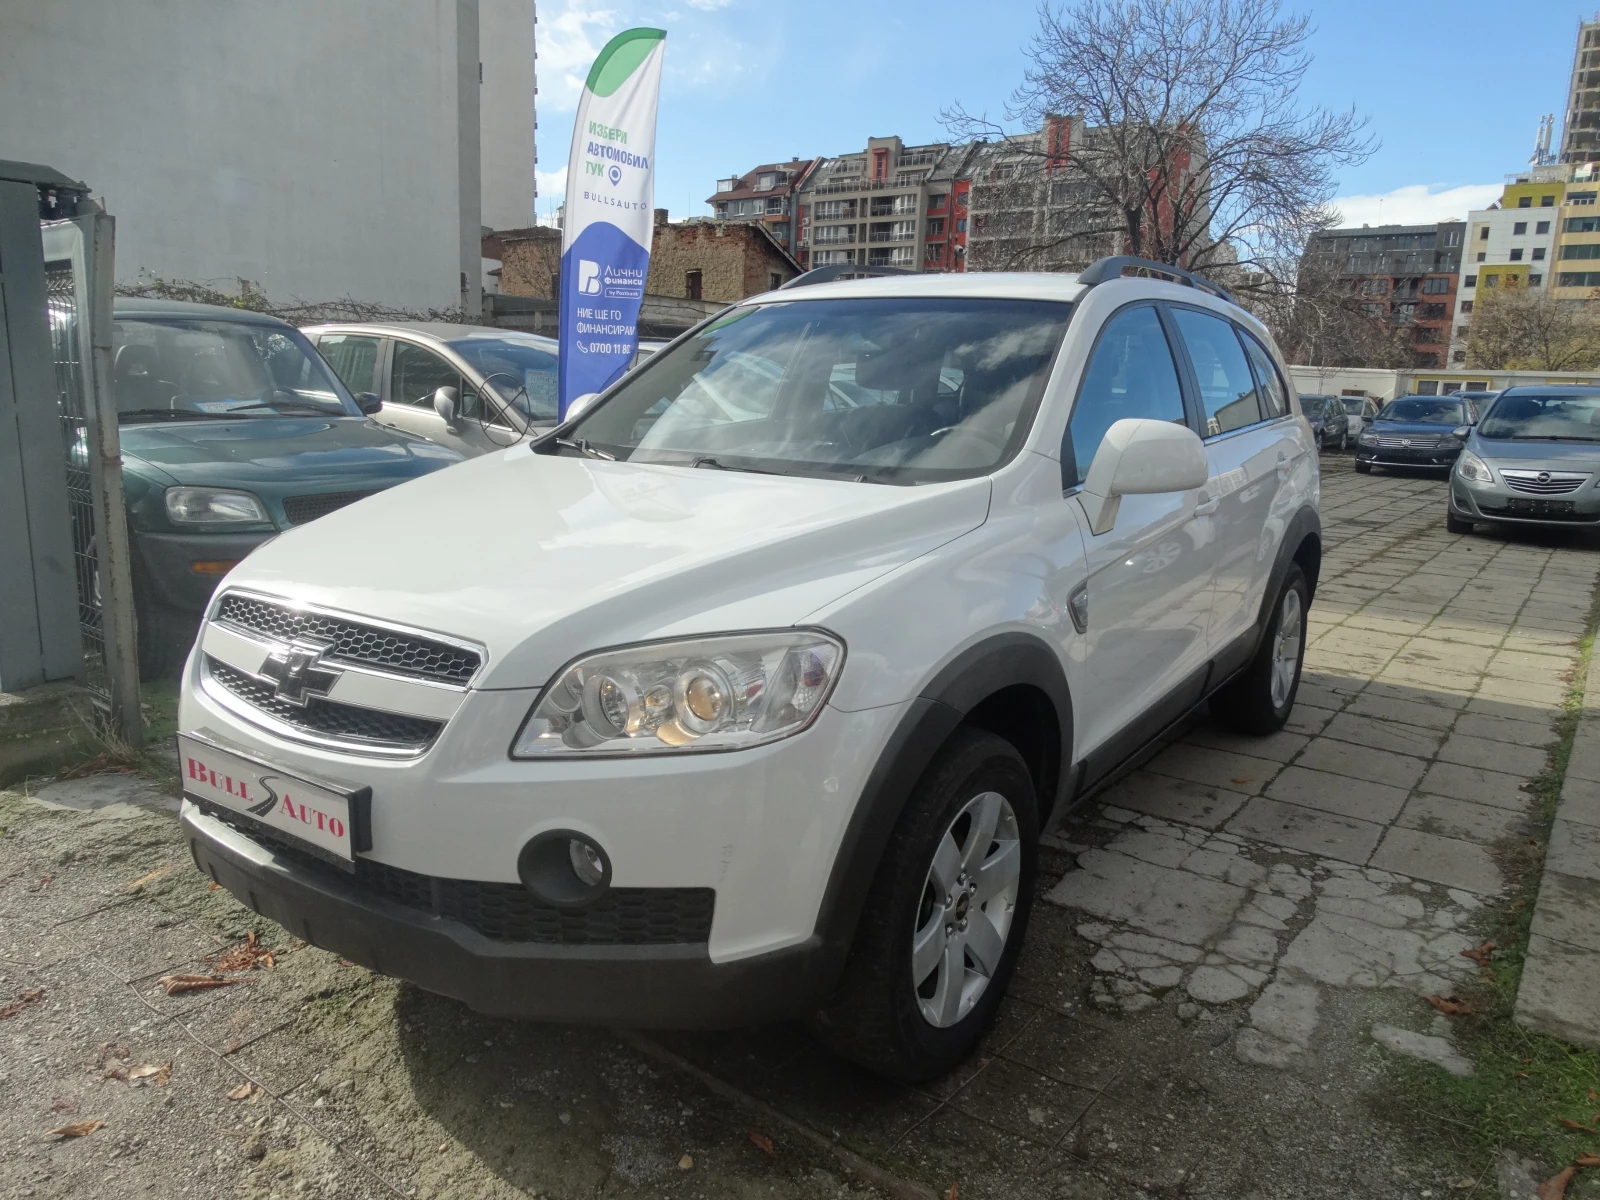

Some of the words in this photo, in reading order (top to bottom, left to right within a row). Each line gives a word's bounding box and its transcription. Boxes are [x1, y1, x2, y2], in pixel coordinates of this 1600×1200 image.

[588, 121, 627, 144] ИЗБЕРИ
[587, 141, 649, 169] АВТОМОБИЛ
[585, 160, 605, 177] ТУК
[584, 191, 647, 210] BULLSAUTO
[577, 307, 593, 319] НИЕ
[595, 309, 608, 320] ЩЕ
[610, 310, 622, 320] ГО
[590, 342, 611, 354] 0700
[613, 344, 620, 354] 11
